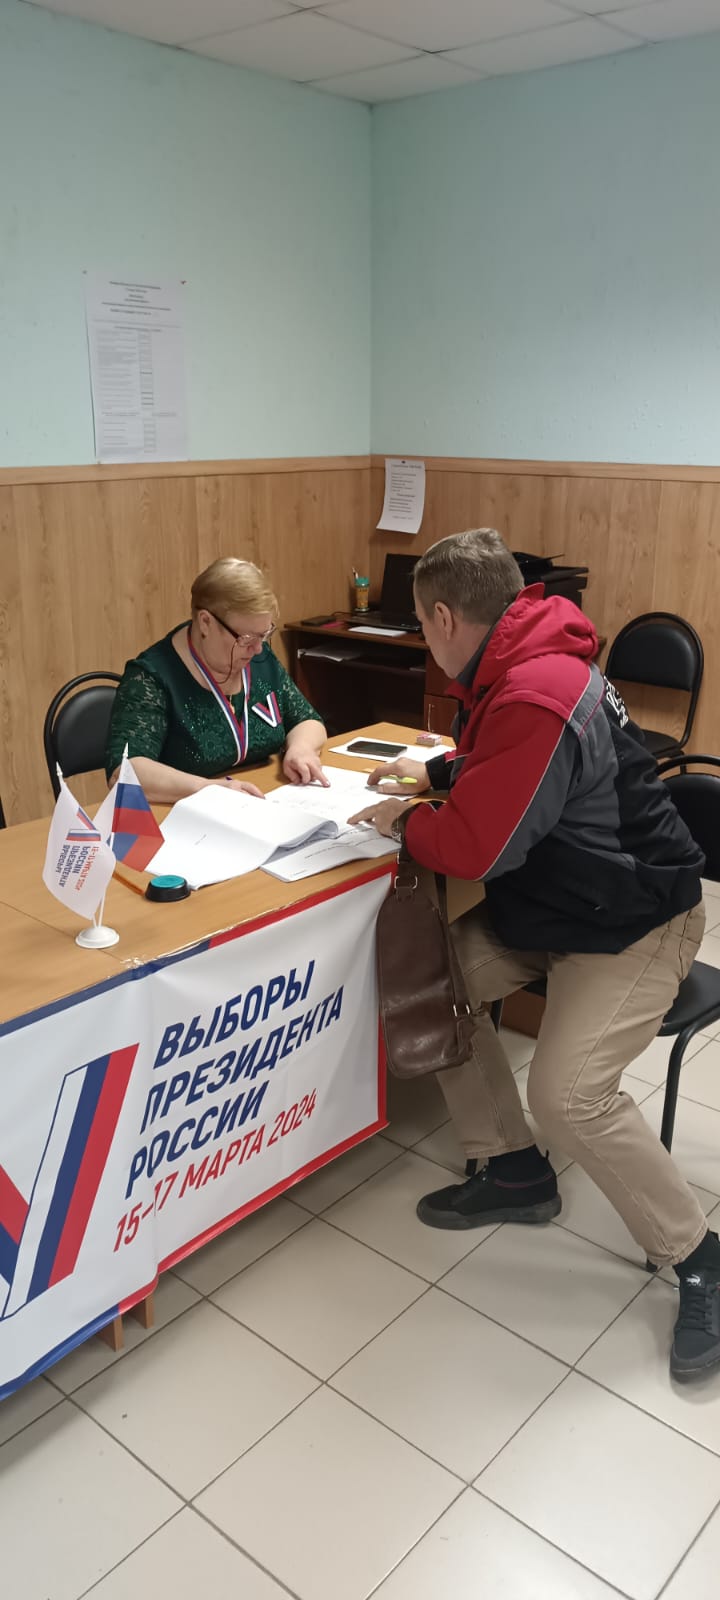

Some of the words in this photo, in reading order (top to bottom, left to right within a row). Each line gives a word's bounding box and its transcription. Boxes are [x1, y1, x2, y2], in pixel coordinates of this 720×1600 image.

[140, 985, 344, 1135] ПРЕЗИДЕНТА
[153, 959, 315, 1070] ВЫБОРЫ
[125, 1080, 270, 1200] РОССИИ
[178, 1124, 266, 1199] МАРТА
[266, 1088, 317, 1147] 2024
